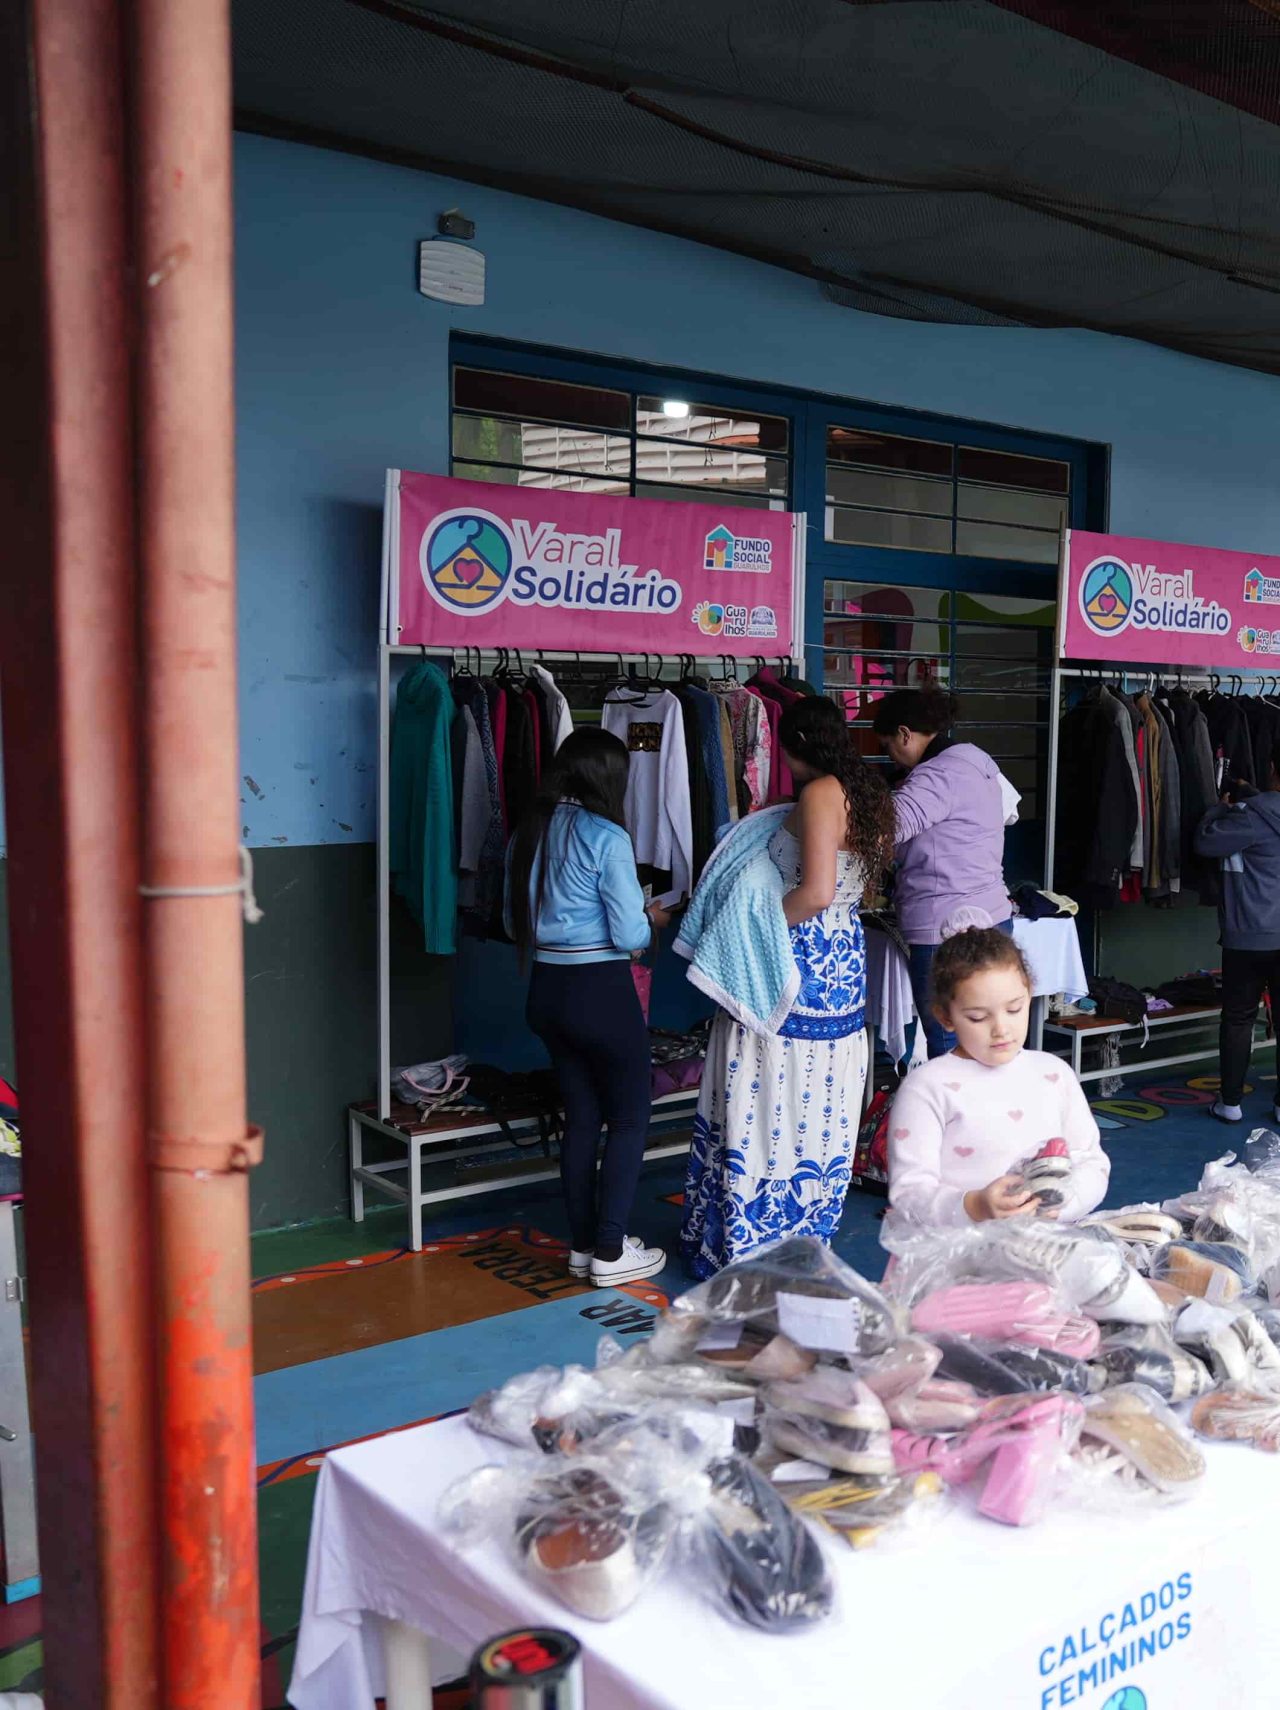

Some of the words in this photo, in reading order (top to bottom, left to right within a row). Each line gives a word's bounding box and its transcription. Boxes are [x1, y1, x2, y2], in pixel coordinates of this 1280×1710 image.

[514, 522, 620, 567] Varal
[734, 539, 770, 552] FUNDO
[734, 552, 770, 563] SOCIAL
[511, 565, 677, 609] Solidário
[1134, 566, 1191, 598] Varal
[726, 606, 746, 617] Gua
[1133, 598, 1228, 631] Solidário
[725, 625, 746, 635] lhos
[1039, 1572, 1192, 1676] CALÇADOS
[1041, 1612, 1192, 1710] FEMININOS
